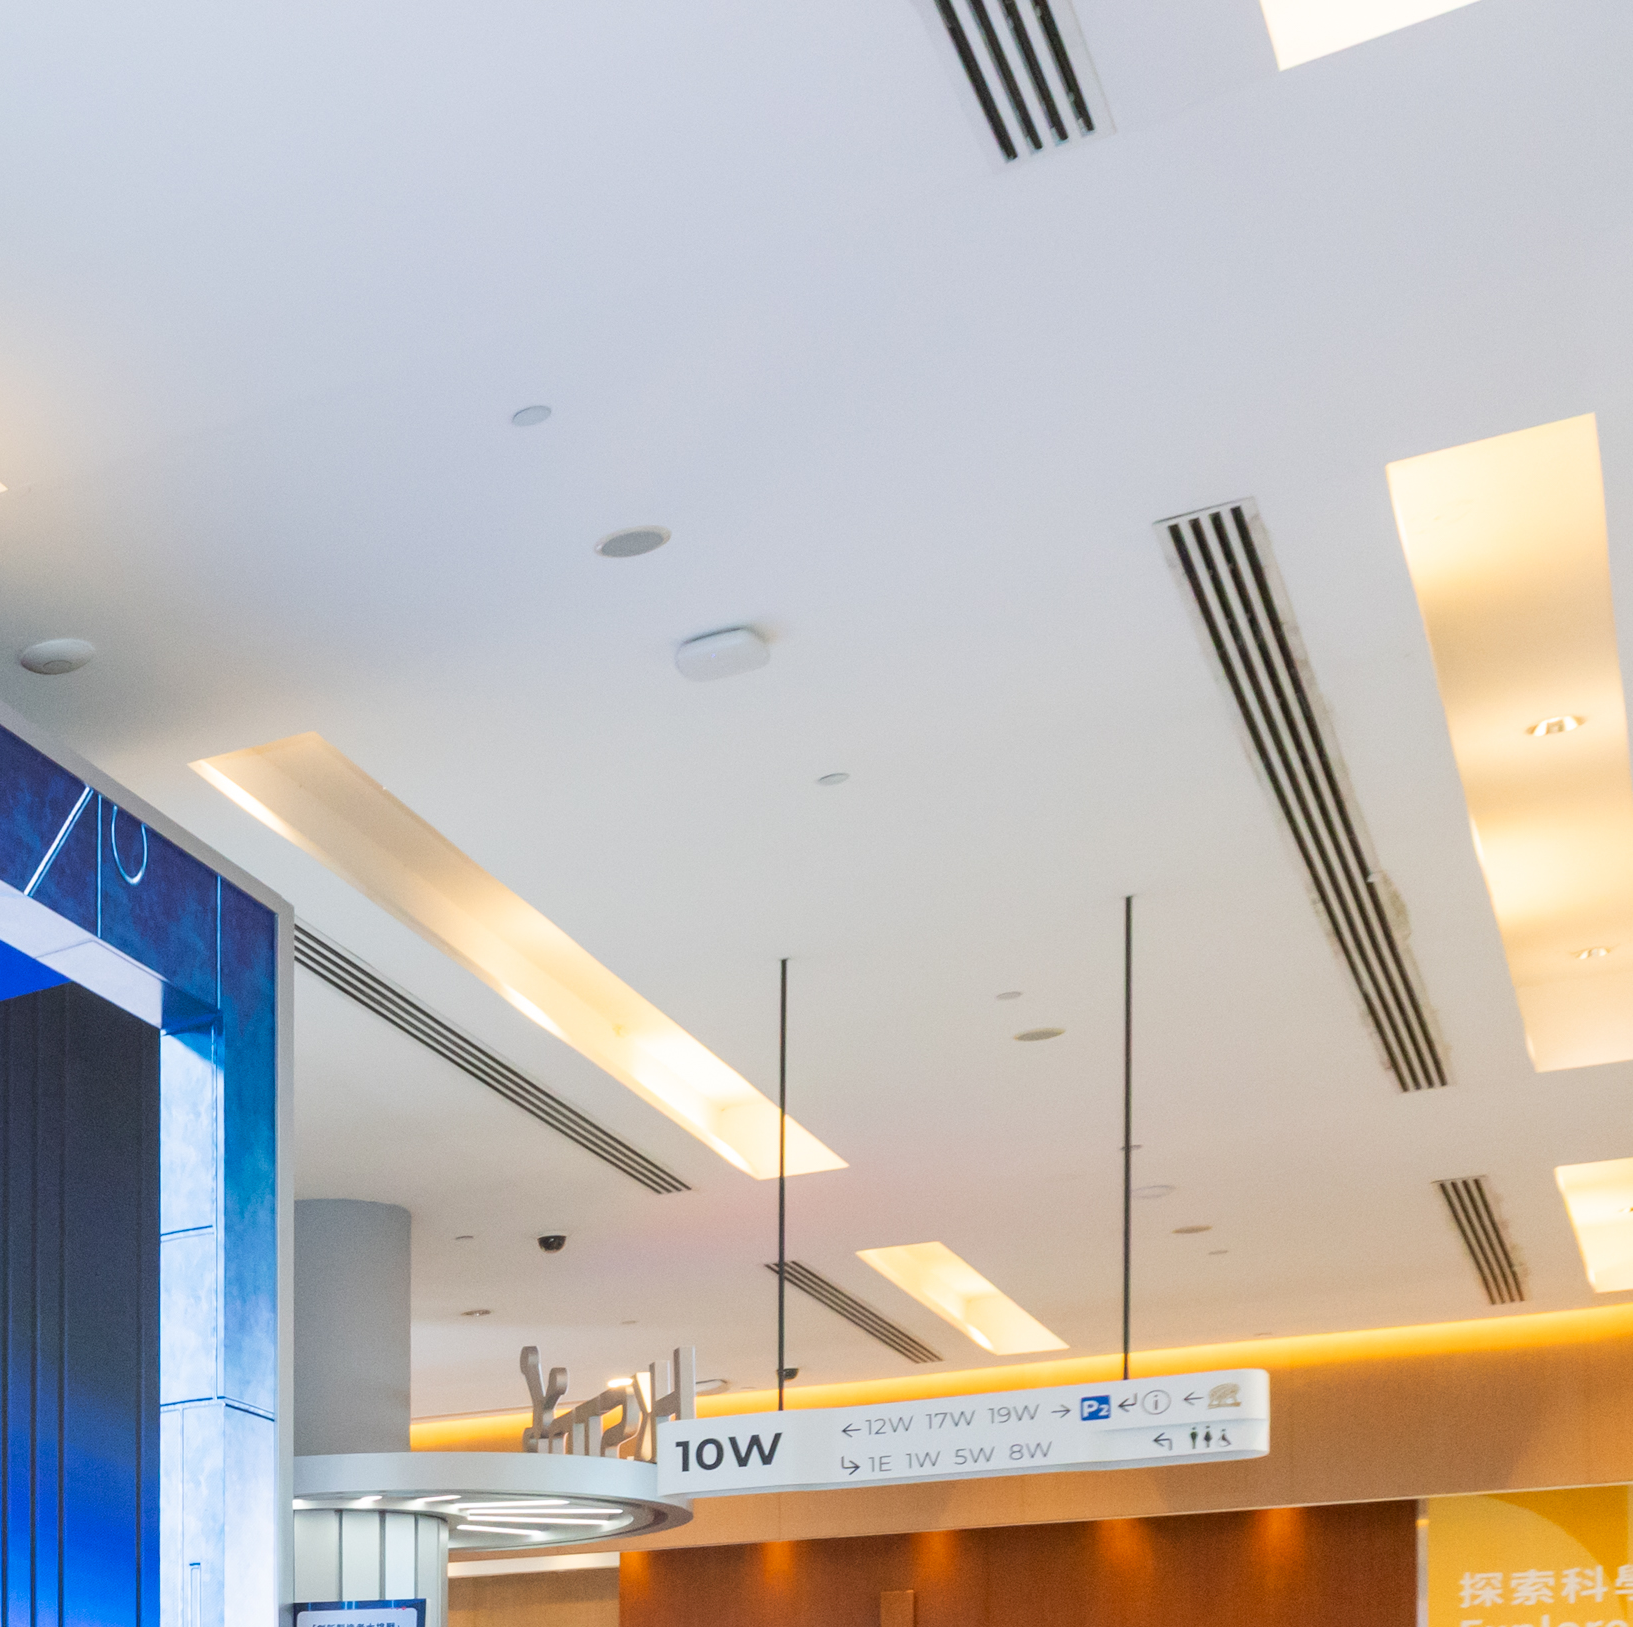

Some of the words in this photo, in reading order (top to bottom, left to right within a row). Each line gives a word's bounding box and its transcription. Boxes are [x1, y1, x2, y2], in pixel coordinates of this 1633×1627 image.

[865, 1415, 914, 1436] 12W
[926, 1410, 976, 1430] 17W
[987, 1404, 1040, 1424] 19W
[676, 1432, 783, 1473] 10W
[869, 1456, 891, 1473] 1E
[906, 1451, 941, 1469] 1W
[954, 1447, 995, 1466] 5W
[1009, 1441, 1052, 1461] 8W
